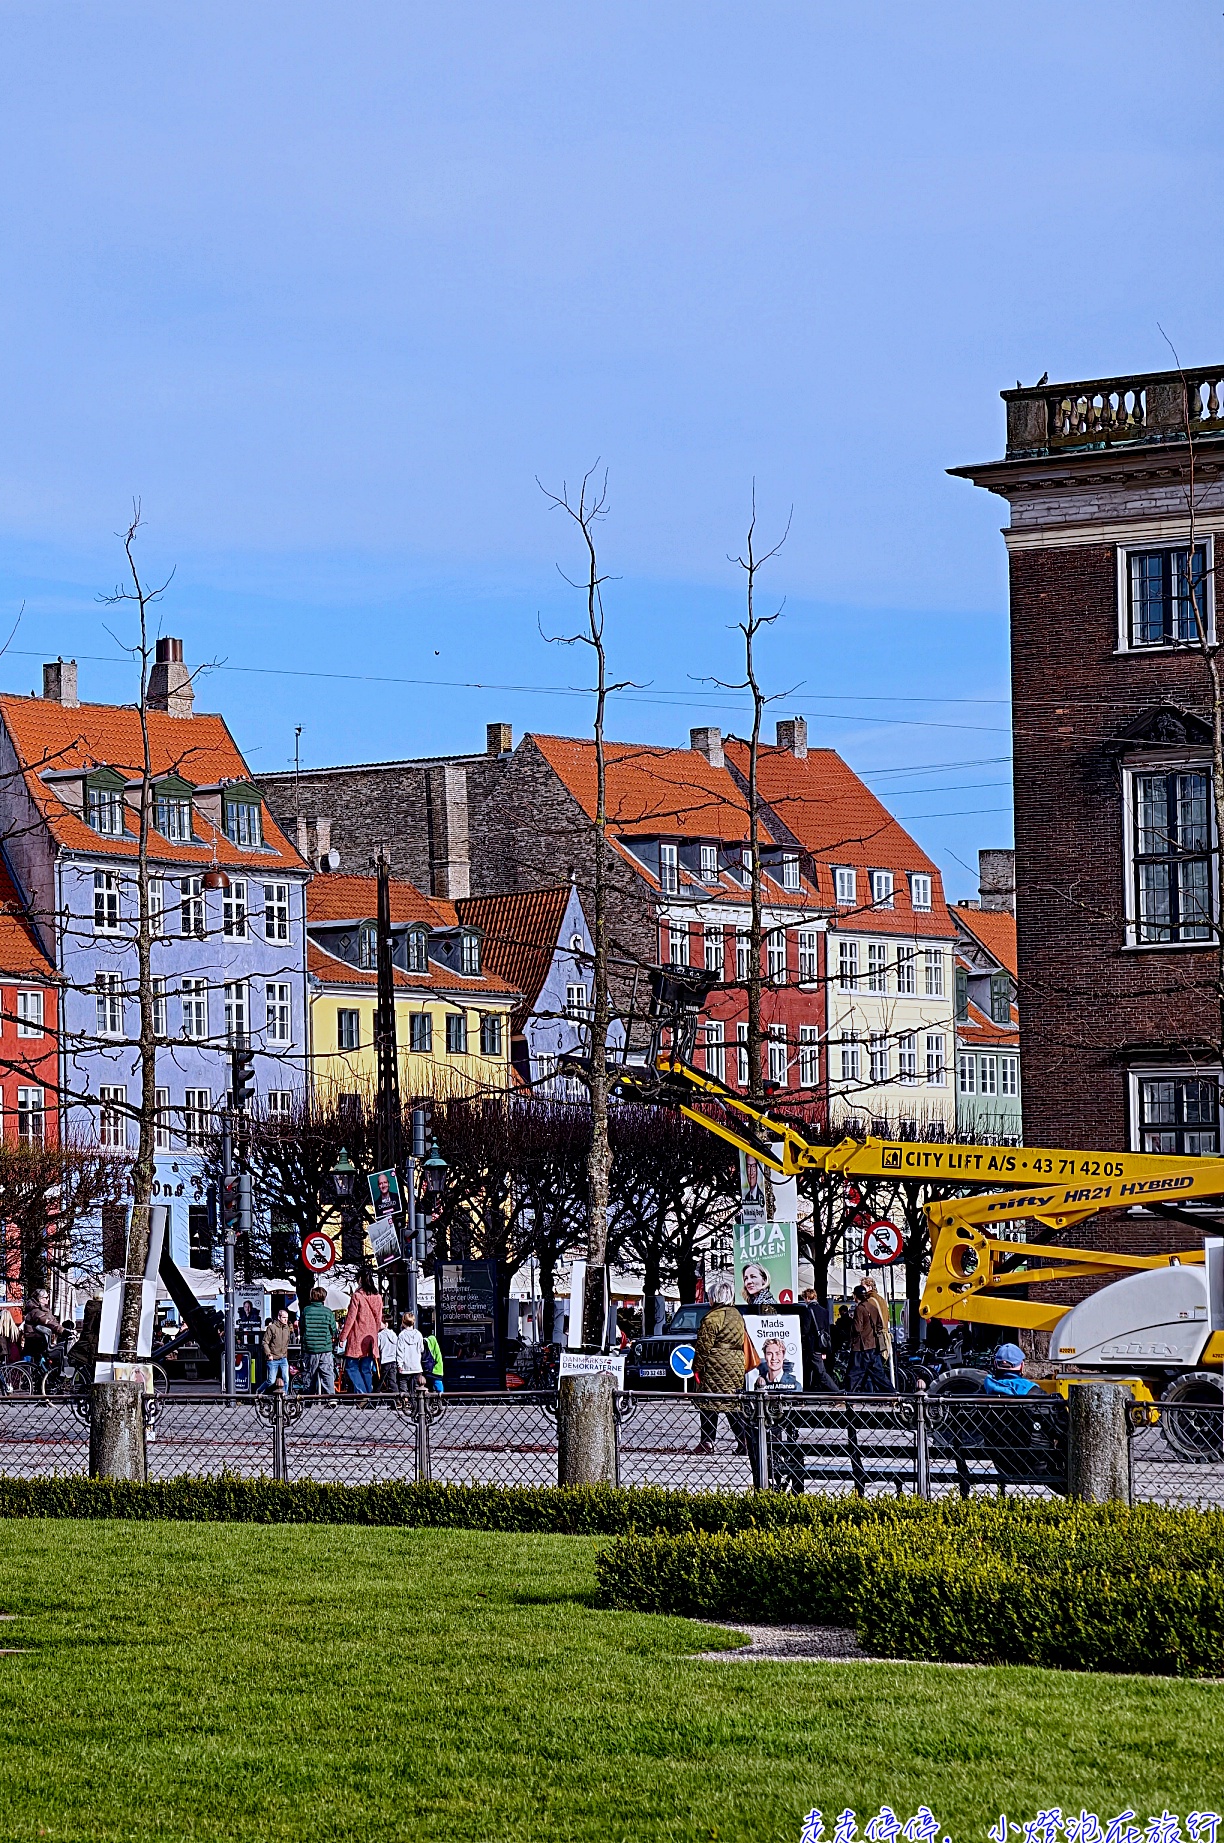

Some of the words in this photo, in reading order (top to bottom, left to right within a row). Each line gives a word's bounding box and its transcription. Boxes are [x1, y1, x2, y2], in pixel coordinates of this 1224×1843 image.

[906, 1152, 944, 1168] CITY
[948, 1154, 980, 1170] LIFT
[987, 1155, 1017, 1172] A/S
[1032, 1158, 1053, 1174] 43
[1058, 1159, 1076, 1175] 71
[1079, 1160, 1101, 1176] 42
[1103, 1161, 1124, 1177] 05
[987, 1194, 1056, 1212] nifty
[1064, 1187, 1111, 1204] HR21
[1120, 1176, 1194, 1197] HYBRID
[739, 1222, 786, 1248] IDA
[739, 1241, 786, 1260] AUKEN
[783, 1293, 792, 1302] A
[761, 1319, 784, 1328] Mads
[757, 1329, 790, 1339] Strange
[562, 1355, 605, 1365] DANMARKS
[562, 1362, 623, 1372] DEMOKRATERNE
